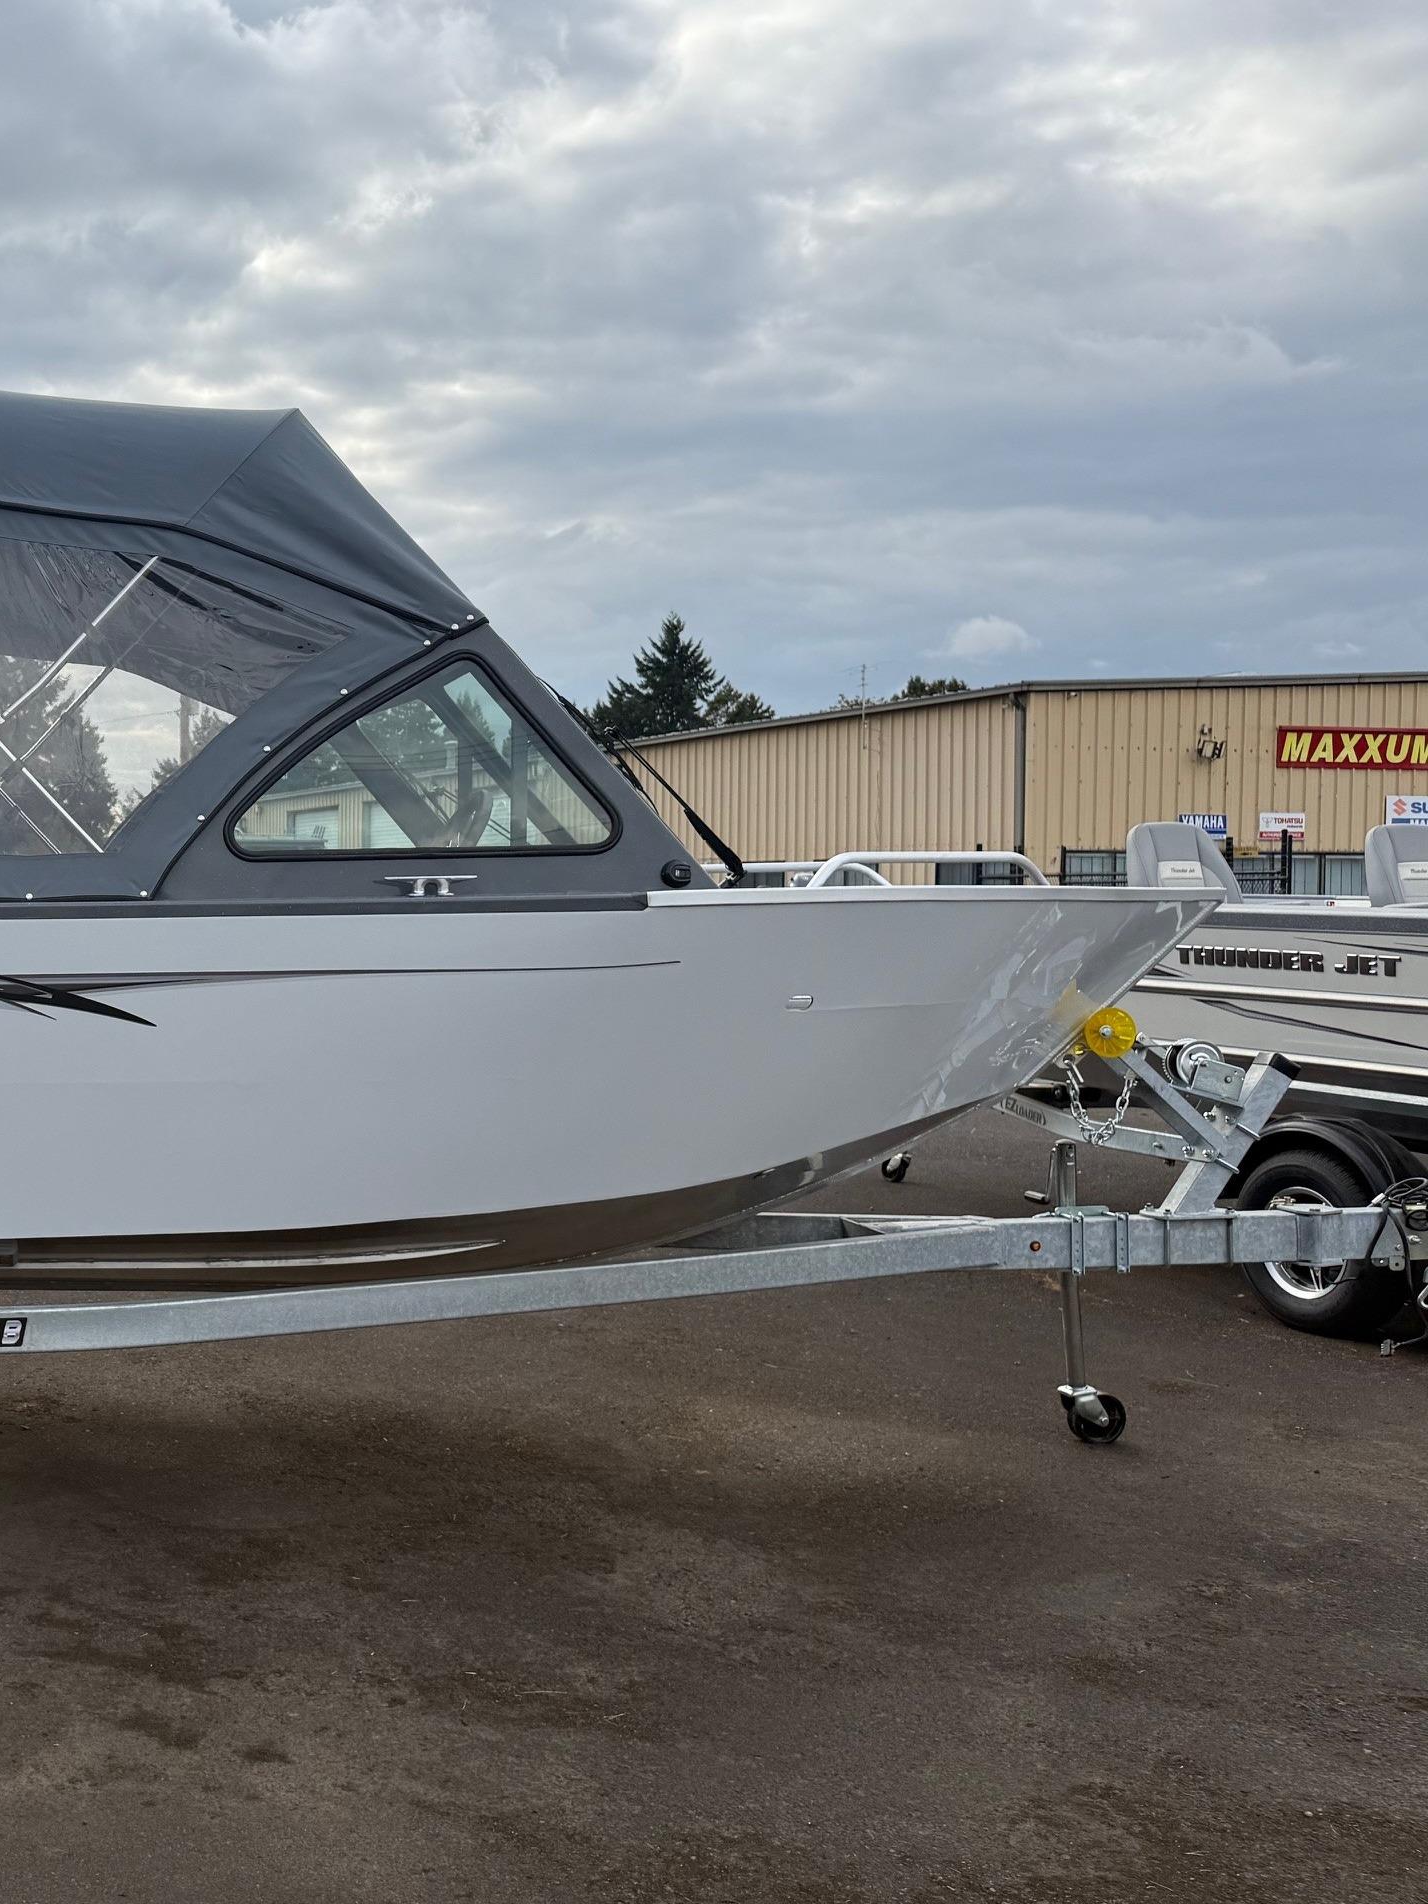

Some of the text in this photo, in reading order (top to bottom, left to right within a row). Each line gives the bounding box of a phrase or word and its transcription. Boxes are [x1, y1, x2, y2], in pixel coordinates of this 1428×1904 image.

[1281, 731, 1428, 764] MAXXUM
[1181, 815, 1224, 829] YAMAHA
[1274, 817, 1303, 825] TOHATSU
[1175, 944, 1401, 977] THUNDER JET
